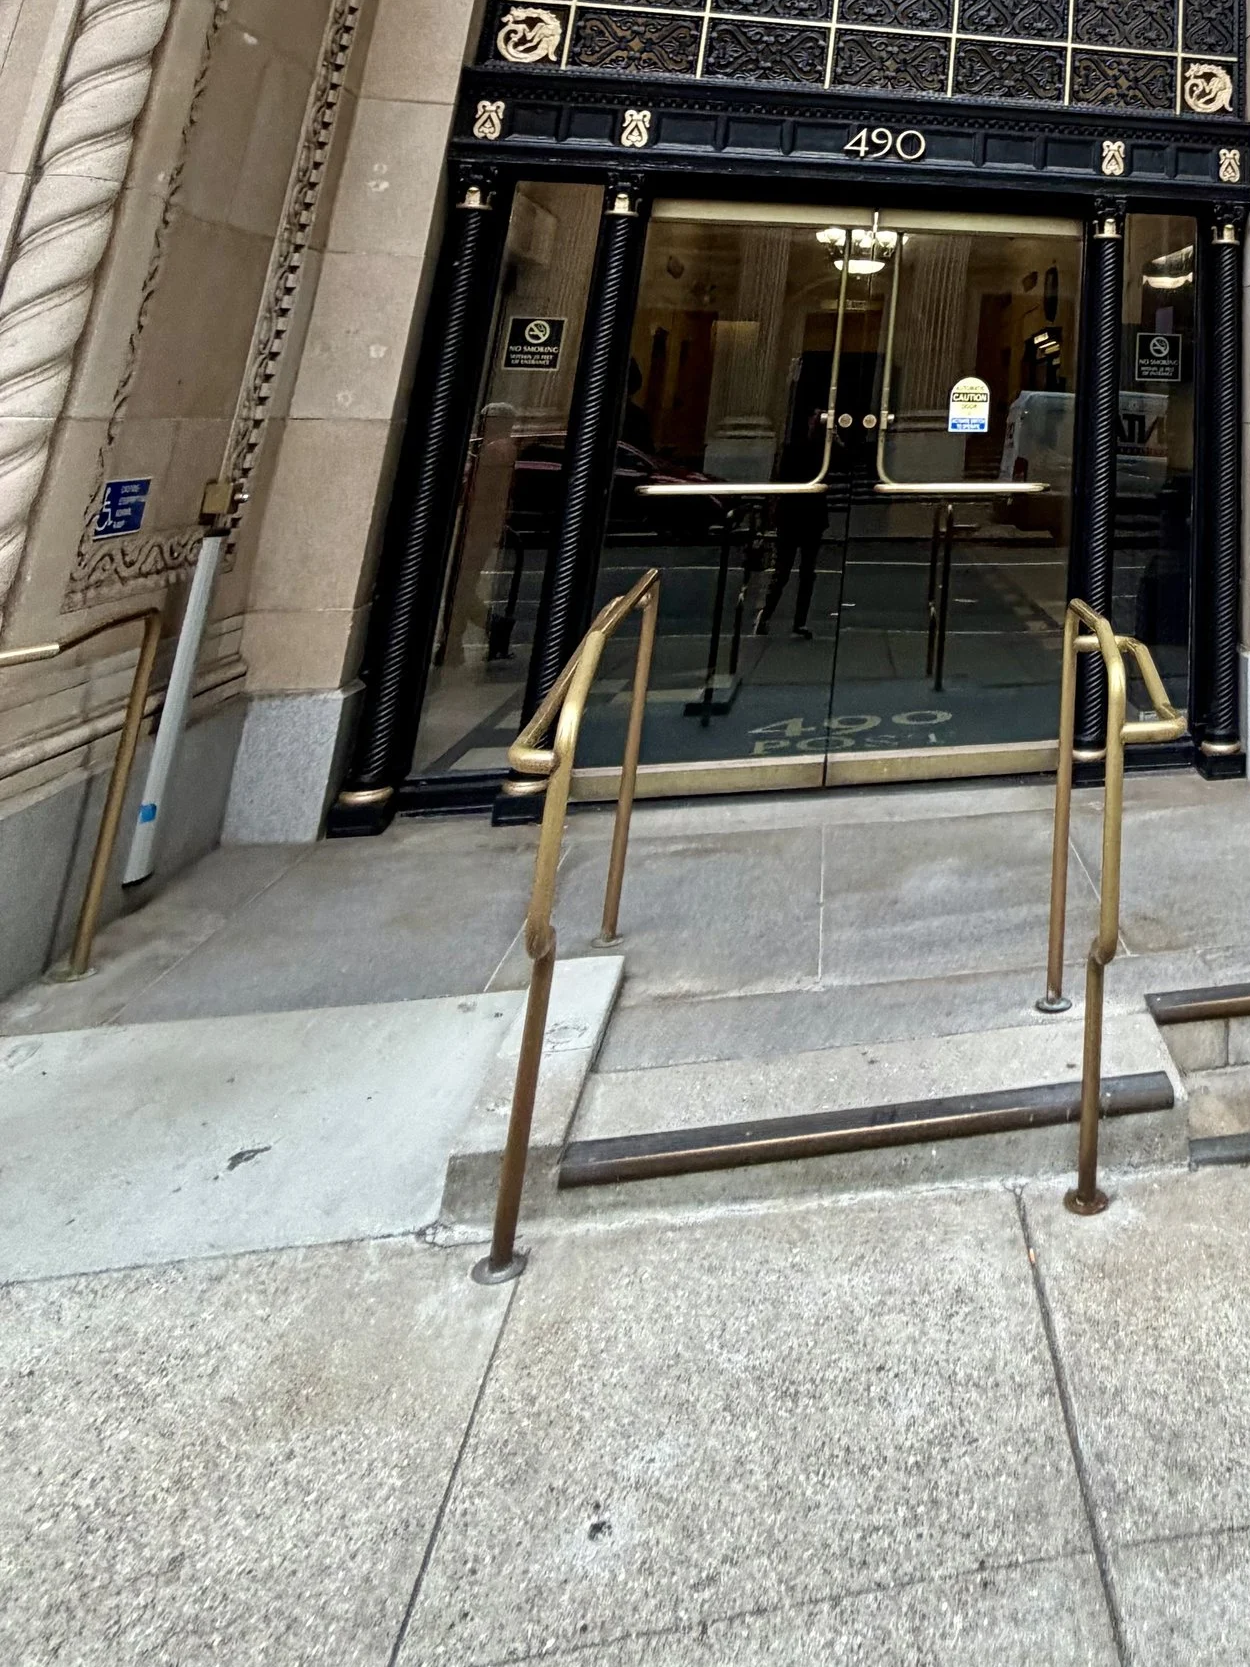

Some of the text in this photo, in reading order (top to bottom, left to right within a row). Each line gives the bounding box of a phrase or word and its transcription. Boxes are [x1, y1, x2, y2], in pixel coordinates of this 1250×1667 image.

[843, 127, 926, 160] 490
[523, 345, 559, 353] SMOKING
[953, 393, 988, 402] CAUTION
[746, 710, 953, 737] 490
